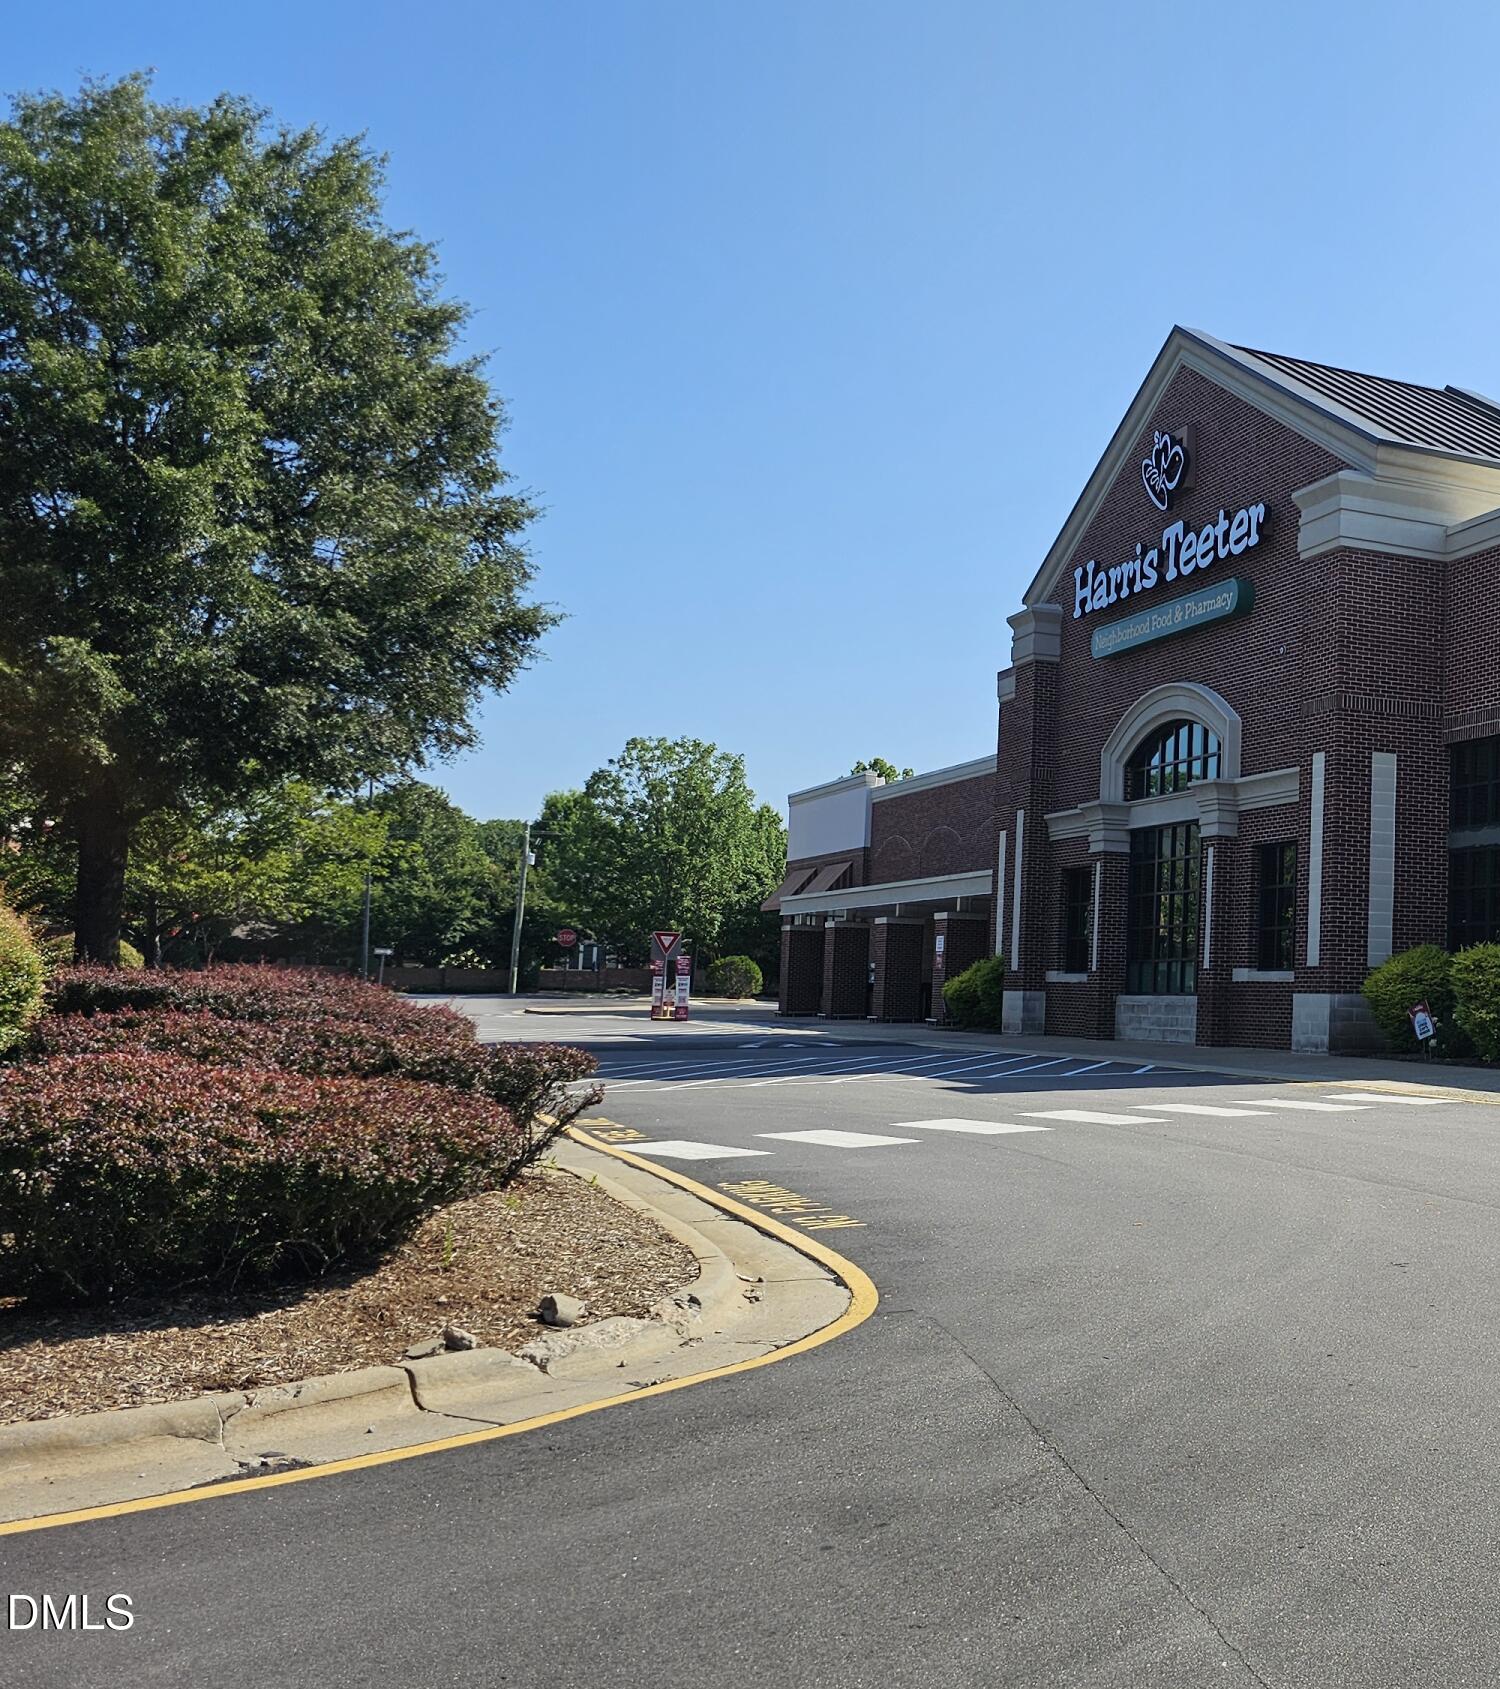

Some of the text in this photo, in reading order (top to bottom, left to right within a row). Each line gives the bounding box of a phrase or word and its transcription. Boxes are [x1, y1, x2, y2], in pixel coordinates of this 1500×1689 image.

[1073, 503, 1265, 619] Harris Teeter
[1095, 592, 1233, 650] Neighborhood Food & Pharmacy
[559, 934, 576, 942] STOP
[792, 1215, 867, 1230] NO
